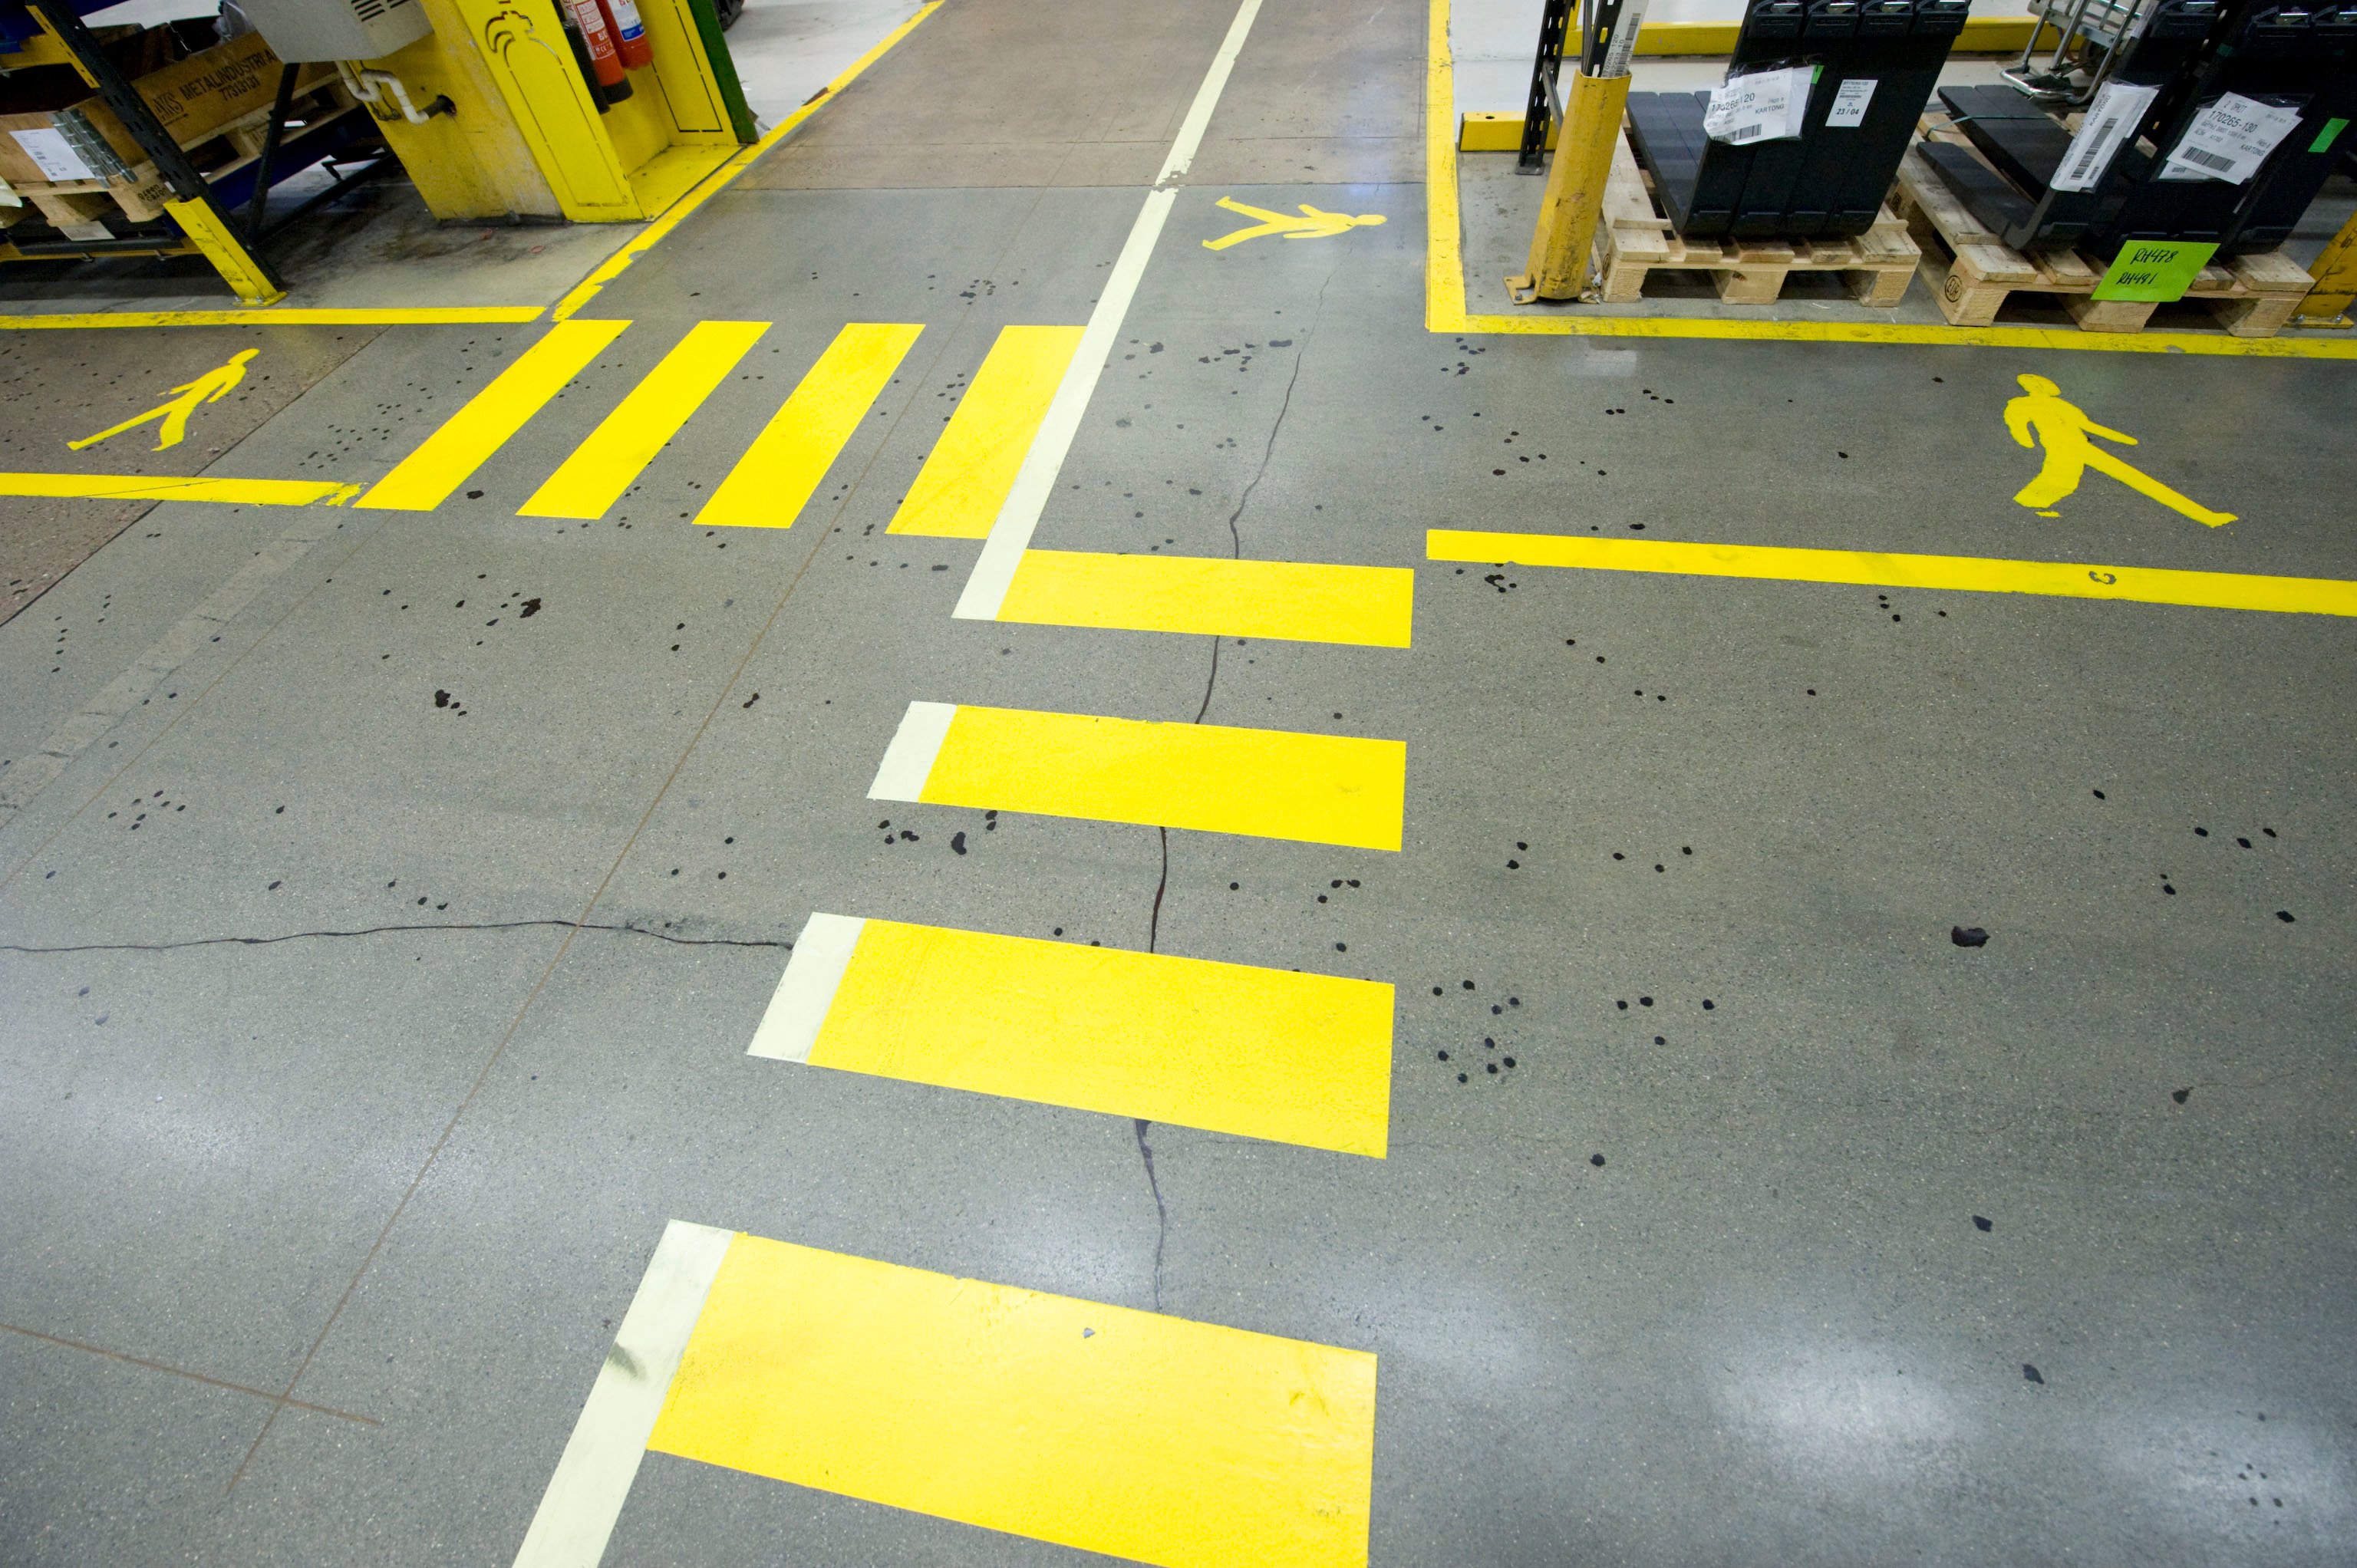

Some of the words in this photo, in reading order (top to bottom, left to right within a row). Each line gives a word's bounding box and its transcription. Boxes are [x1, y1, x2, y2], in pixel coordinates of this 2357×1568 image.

[179, 52, 266, 100] METALINDUSTRI
[1755, 104, 1785, 114] KARTONG
[2209, 110, 2258, 133] 170265-130
[2239, 143, 2266, 156] KARTONG
[2130, 248, 2179, 265] RH478
